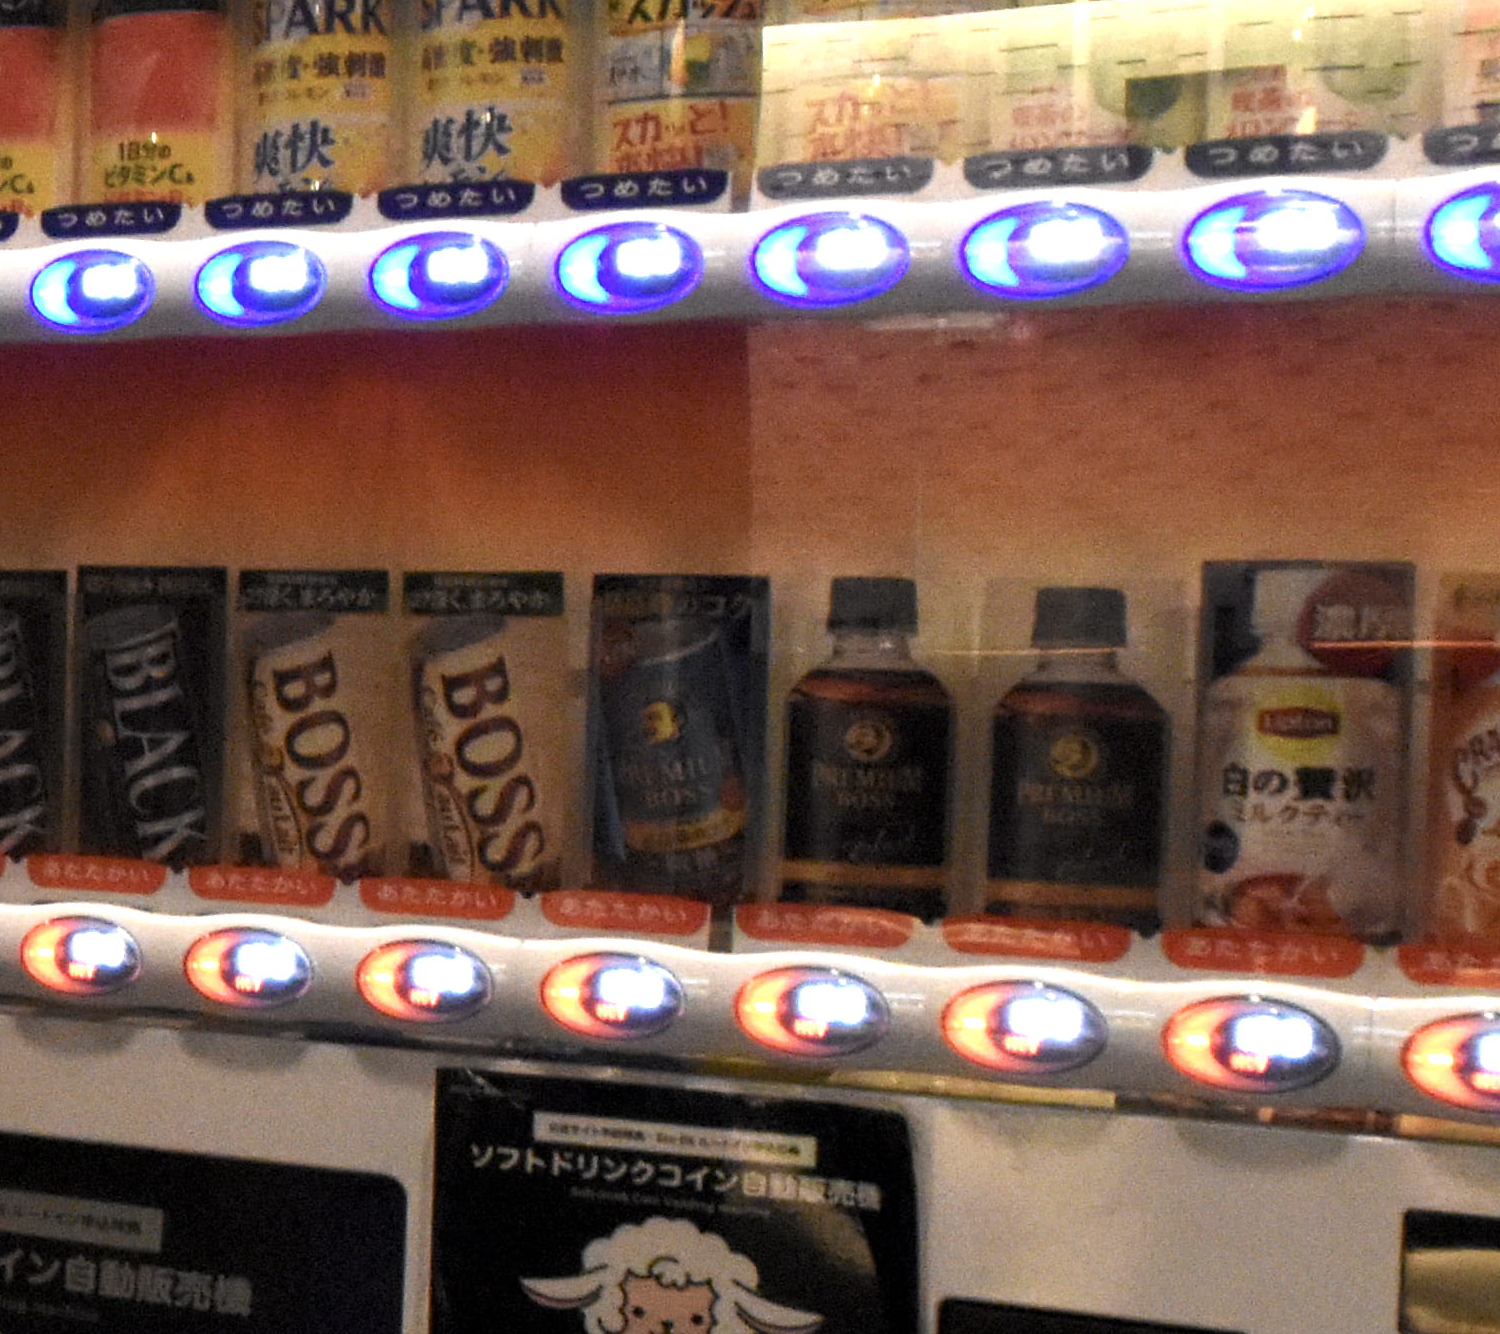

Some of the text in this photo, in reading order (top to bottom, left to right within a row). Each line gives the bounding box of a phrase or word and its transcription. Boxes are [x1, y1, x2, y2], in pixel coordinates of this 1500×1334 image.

[253, 119, 336, 178] 爽快
[419, 105, 513, 168] 爽快
[985, 147, 1132, 179] つめたい
[1206, 137, 1365, 167] つめたい
[580, 174, 710, 203] つめたい
[779, 160, 913, 189] つめたい
[222, 194, 338, 221] つめたい
[396, 186, 520, 216] つめたい
[53, 205, 166, 234] つめたい
[105, 620, 206, 860] BLACK
[273, 651, 370, 879] BOSS
[440, 653, 545, 882] BOSS
[40, 861, 154, 889] あたたかい
[204, 873, 322, 903] あたたかい
[377, 881, 500, 913] あたたかい
[558, 897, 691, 925] あたたかい
